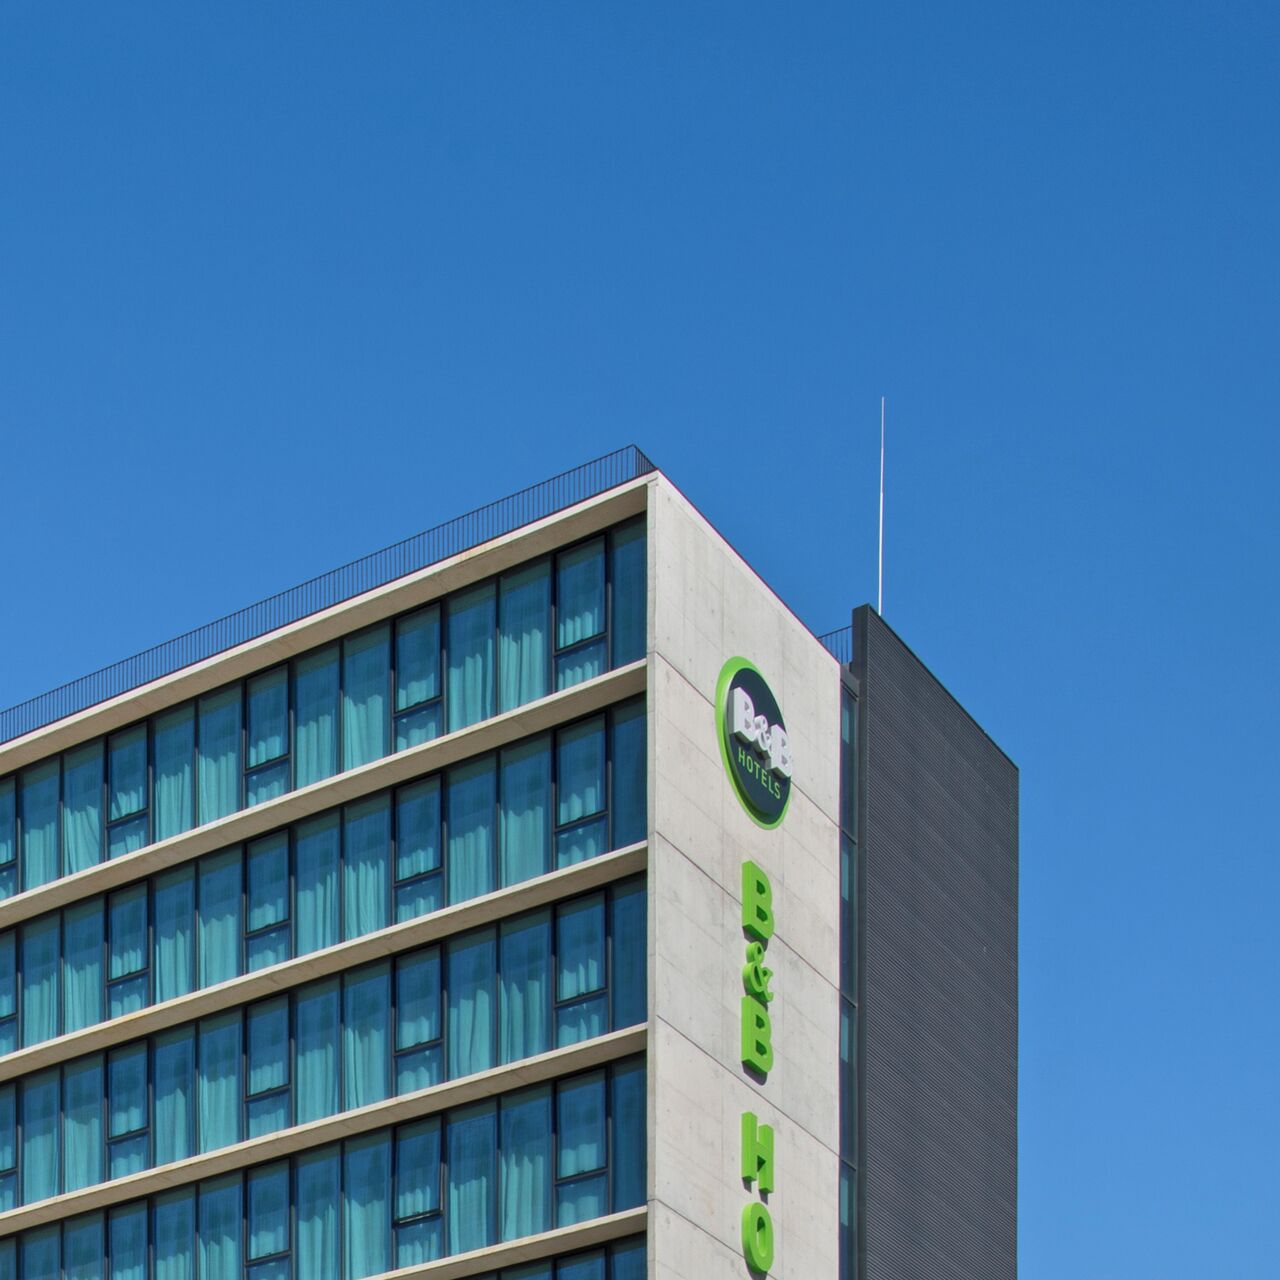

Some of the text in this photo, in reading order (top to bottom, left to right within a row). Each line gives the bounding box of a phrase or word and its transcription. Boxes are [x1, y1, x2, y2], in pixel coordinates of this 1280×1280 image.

[726, 686, 792, 778] B&B
[737, 747, 782, 800] HOTELS
[741, 860, 775, 1074] B&B
